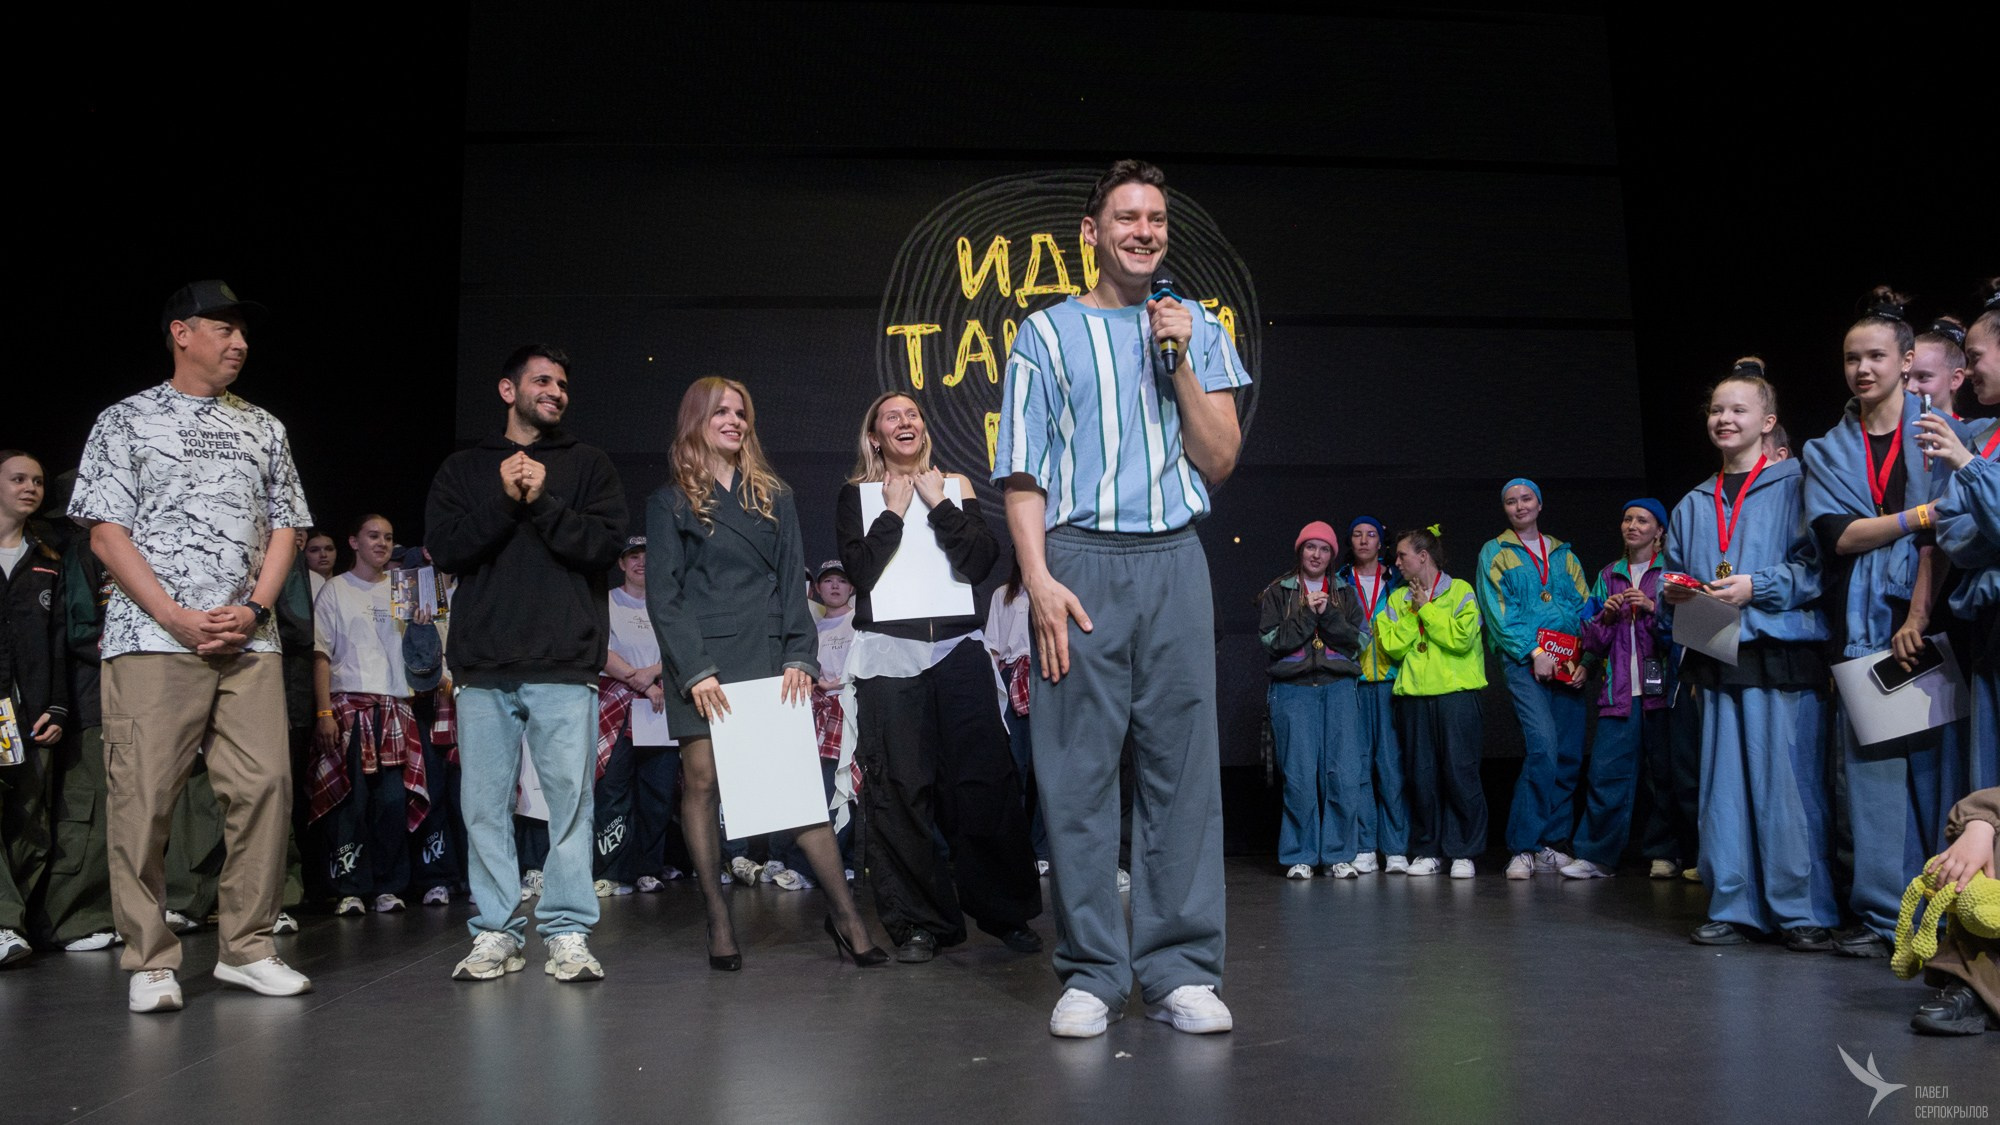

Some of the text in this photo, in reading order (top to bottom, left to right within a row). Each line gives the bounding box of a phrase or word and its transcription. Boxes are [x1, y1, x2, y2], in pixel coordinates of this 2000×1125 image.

[178, 429, 240, 440] GO WHERE
[180, 438, 205, 448] YOU
[183, 448, 251, 461] MOST ALIVE
[1544, 640, 1574, 657] Choco
